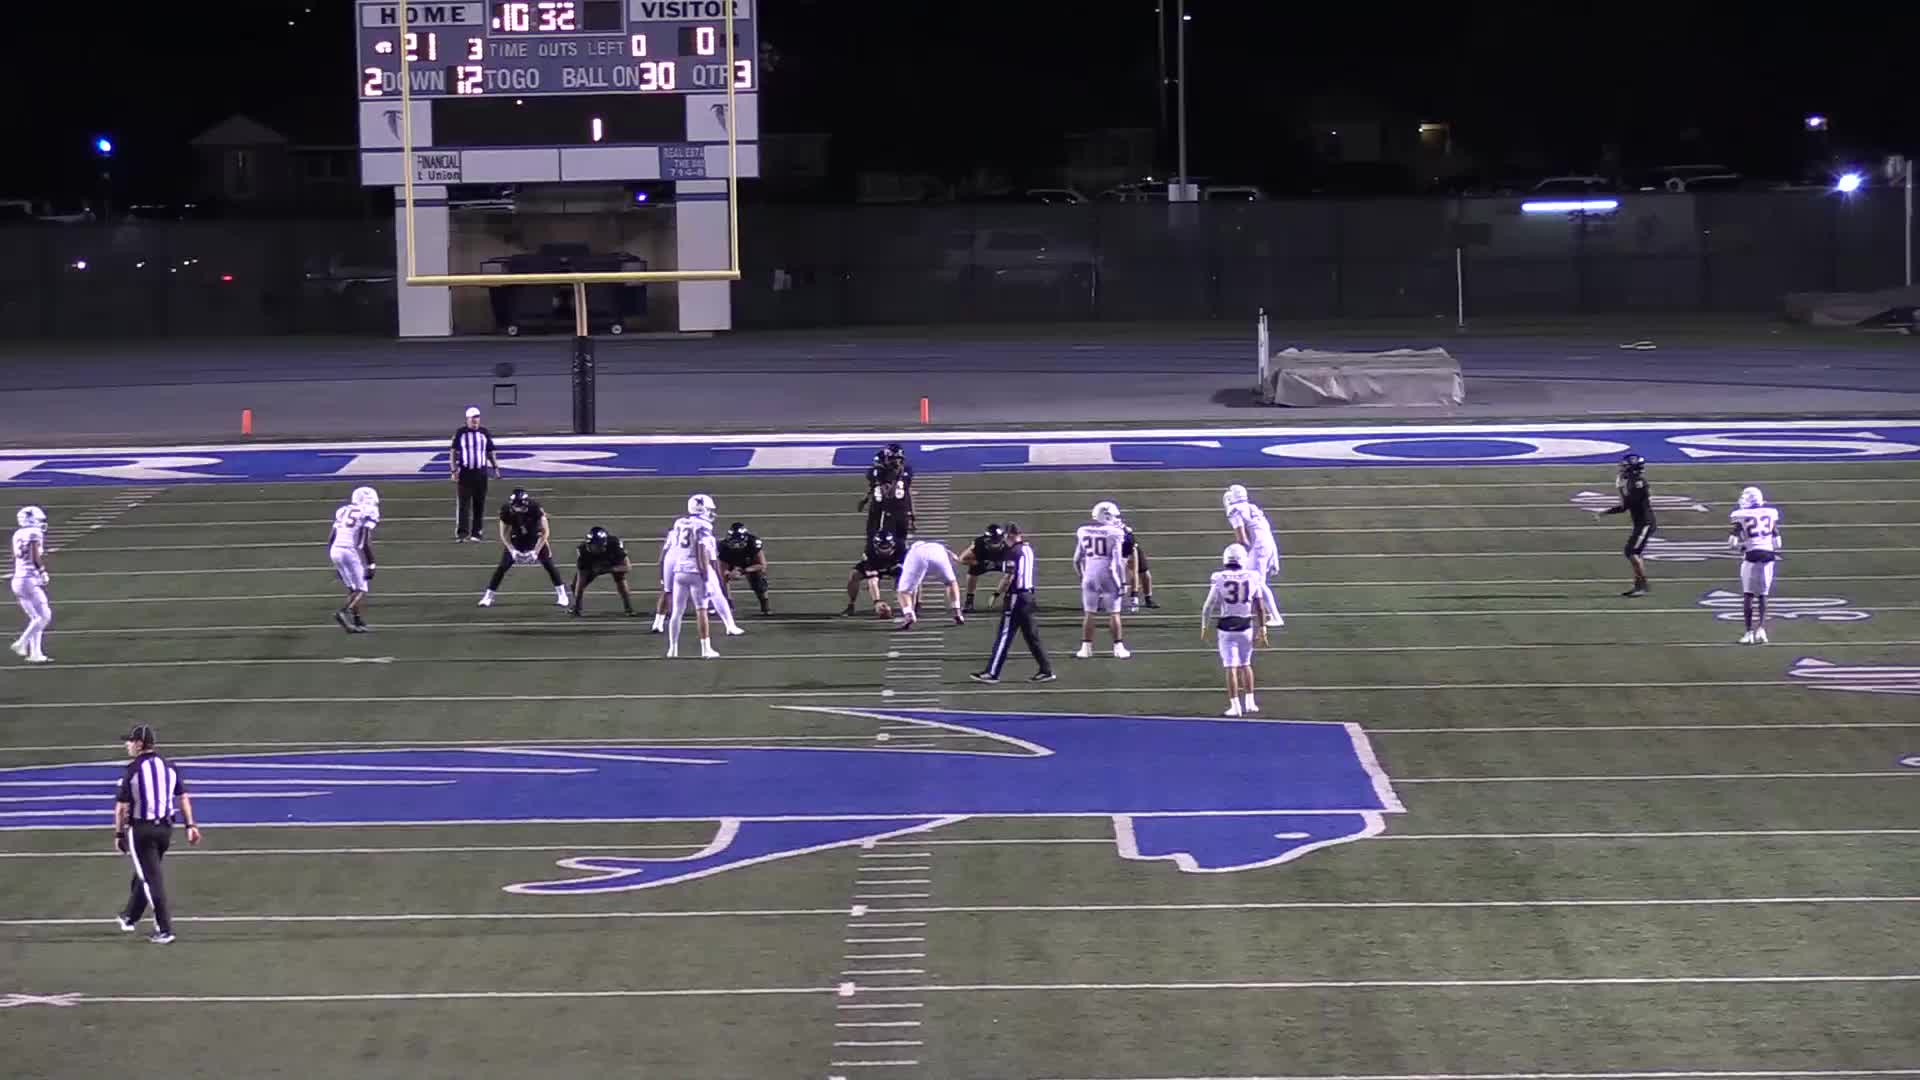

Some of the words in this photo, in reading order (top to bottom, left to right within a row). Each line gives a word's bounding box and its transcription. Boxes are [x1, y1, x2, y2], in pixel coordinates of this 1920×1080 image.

[380, 6, 466, 25] HOME
[404, 32, 437, 62] 21
[467, 38, 483, 61] 3
[489, 42, 528, 57] TIME
[538, 41, 578, 57] OUTS
[587, 40, 624, 56] LEFT
[631, 34, 647, 57] 0
[695, 26, 716, 56] 0
[364, 67, 383, 96] 2
[456, 65, 483, 95] 12
[562, 67, 608, 88] BALL
[613, 66, 639, 88] ON
[640, 61, 675, 91] 30
[734, 59, 752, 89] 3
[417, 155, 460, 169] FINANCIAL
[427, 170, 461, 181] Union
[1744, 515, 1772, 538] 23
[1083, 535, 1108, 557] 20
[1223, 580, 1250, 605] 31
